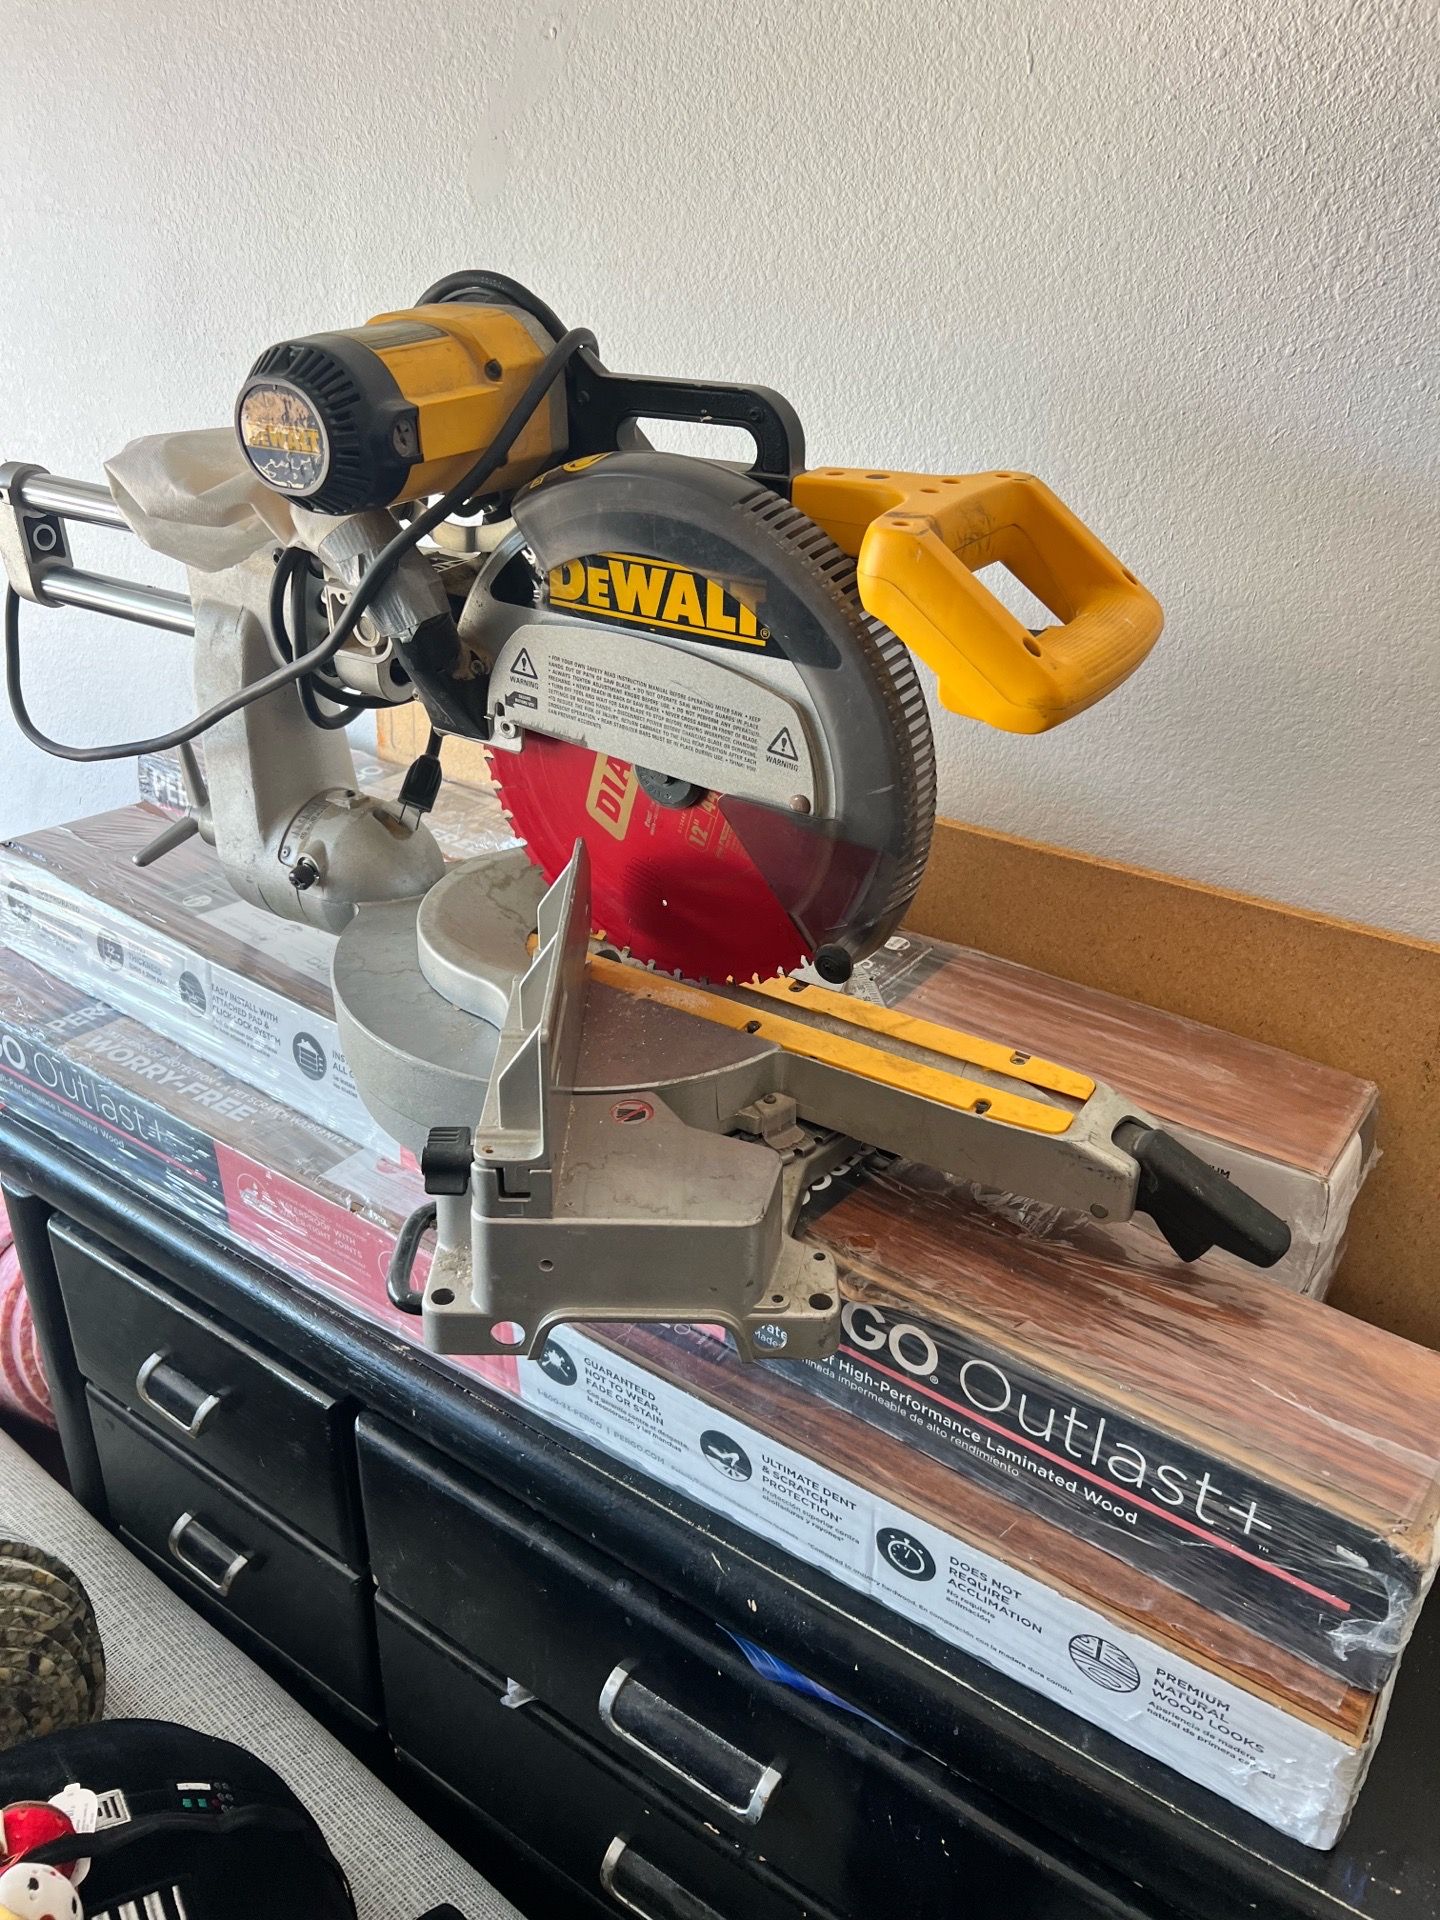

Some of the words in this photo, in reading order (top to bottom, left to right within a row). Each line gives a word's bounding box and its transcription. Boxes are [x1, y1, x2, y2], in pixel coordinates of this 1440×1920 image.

[510, 676, 539, 690] WARNING
[765, 754, 799, 772] WARNING
[212, 995, 246, 1019] ATTACHED
[248, 1013, 262, 1027] PAD
[230, 992, 258, 1013] INSTALL
[259, 1008, 279, 1024] WITH
[84, 1033, 258, 1122] WORRY-FREE
[333, 1062, 348, 1075] ALL
[57, 1104, 99, 1135] Laminated
[100, 1126, 125, 1149] Wood
[584, 1357, 656, 1401] GUARANTEED
[585, 1367, 607, 1384] NOT
[610, 1380, 624, 1393] TO
[625, 1389, 662, 1416] WEAR,
[586, 1378, 613, 1397] FADE
[615, 1394, 631, 1407] OR
[633, 1403, 664, 1426] STAIN
[613, 1432, 665, 1464] PERGO.COM
[839, 1374, 907, 1417] impermeable
[909, 1412, 924, 1427] de
[926, 1422, 947, 1438] alto
[950, 1434, 1019, 1477] rendimiento
[840, 1359, 980, 1443] High-Performance
[986, 1437, 1077, 1493] Laminated
[1083, 1486, 1138, 1525] Wood
[959, 1360, 1272, 1535] Outlast+
[762, 1454, 820, 1490] ULTIMATE
[823, 1487, 857, 1511] DENT
[762, 1465, 770, 1475] &
[773, 1471, 828, 1506] SCRATCH
[762, 1487, 801, 1512] Protección
[803, 1510, 833, 1530] superior
[834, 1527, 860, 1544] contra
[949, 1567, 1010, 1605] REQUIRE
[950, 1556, 987, 1582] DOES
[991, 1578, 1022, 1599] NOT
[946, 1588, 959, 1599] No
[960, 1596, 995, 1619] requiere
[946, 1596, 991, 1624] aclimación
[948, 1578, 1042, 1634] ACCLIMATION
[929, 1608, 974, 1639] comparación
[975, 1636, 989, 1646] con
[998, 1650, 1027, 1668] madera
[1028, 1664, 1045, 1677] dura
[1153, 1678, 1229, 1724] NATURAL
[1156, 1667, 1230, 1711] PREMIUM
[1147, 1708, 1181, 1729] natural
[1182, 1727, 1196, 1737] de
[1197, 1735, 1236, 1759] primera
[1148, 1701, 1201, 1731] Apariencia
[1202, 1729, 1216, 1740] de
[1218, 1738, 1256, 1761] madera
[1152, 1688, 1204, 1721] WOOD
[1208, 1719, 1265, 1754] LOOKS
